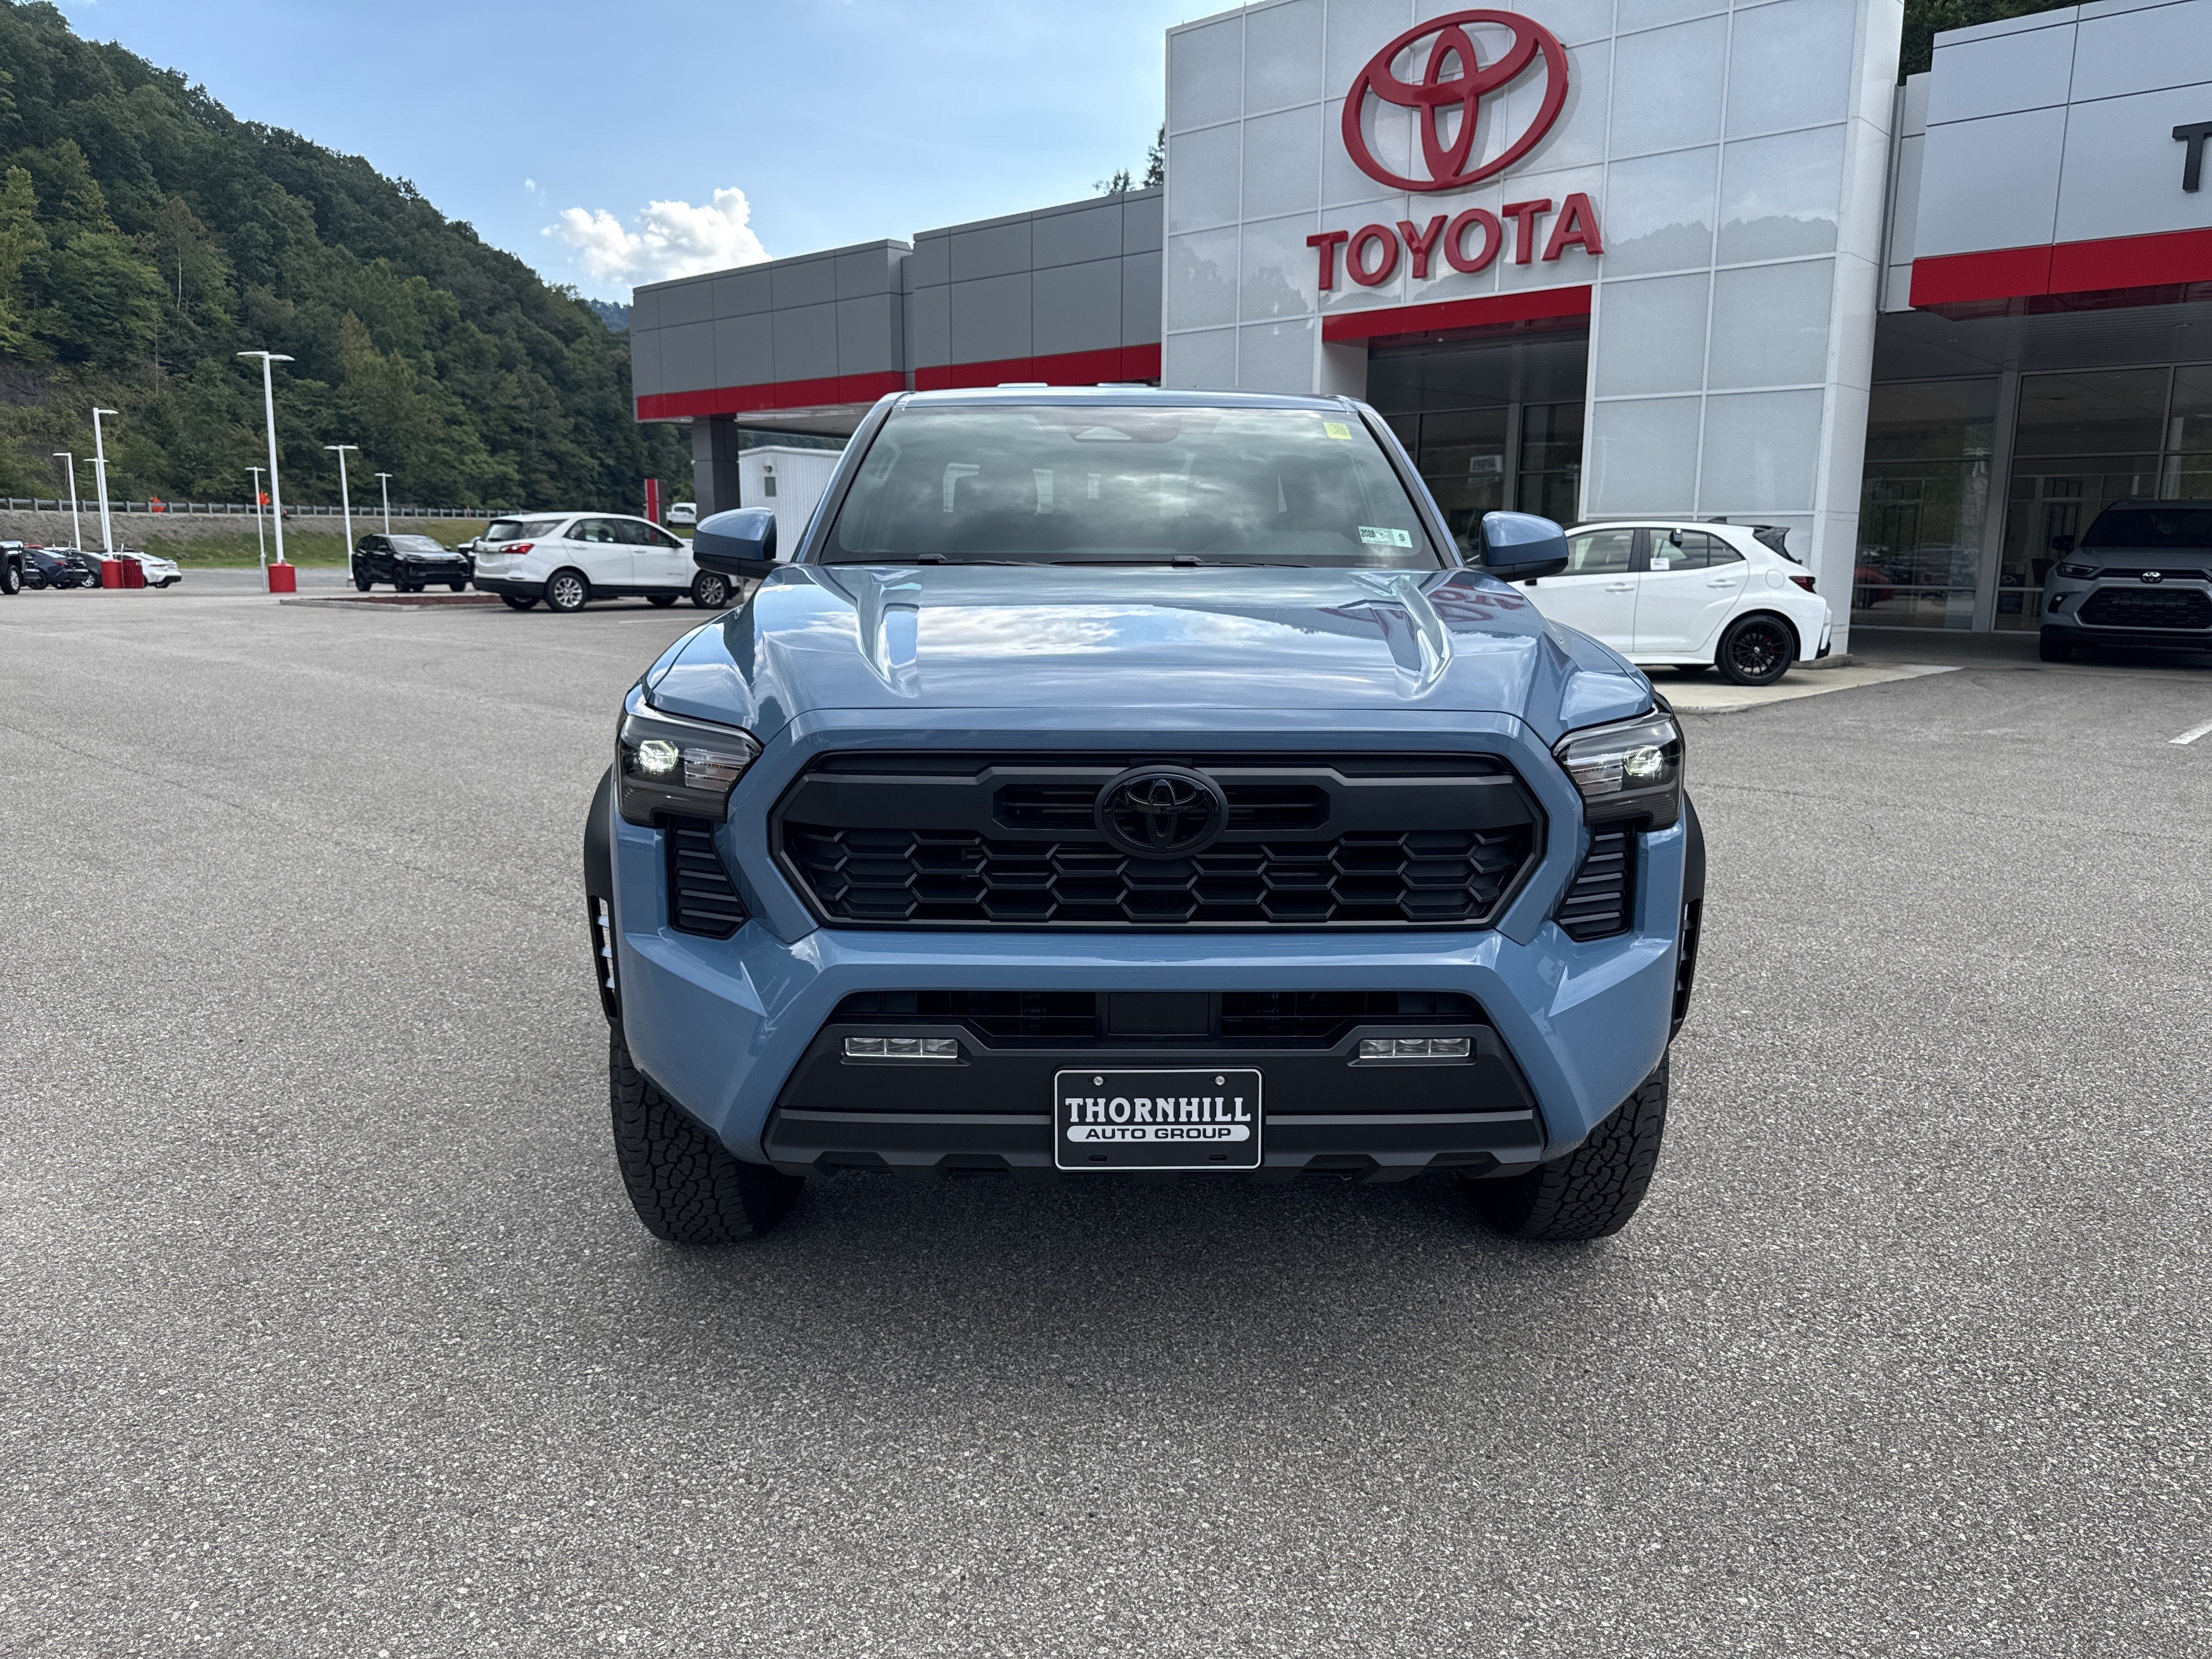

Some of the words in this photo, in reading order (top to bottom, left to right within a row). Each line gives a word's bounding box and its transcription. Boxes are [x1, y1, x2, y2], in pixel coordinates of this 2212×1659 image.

[1307, 193, 1604, 291] TOYOTA
[1398, 533, 1405, 541] 9
[1065, 1097, 1251, 1123] THORNHILL
[1085, 1128, 1146, 1139] AUTO
[1154, 1127, 1231, 1139] GROUP
